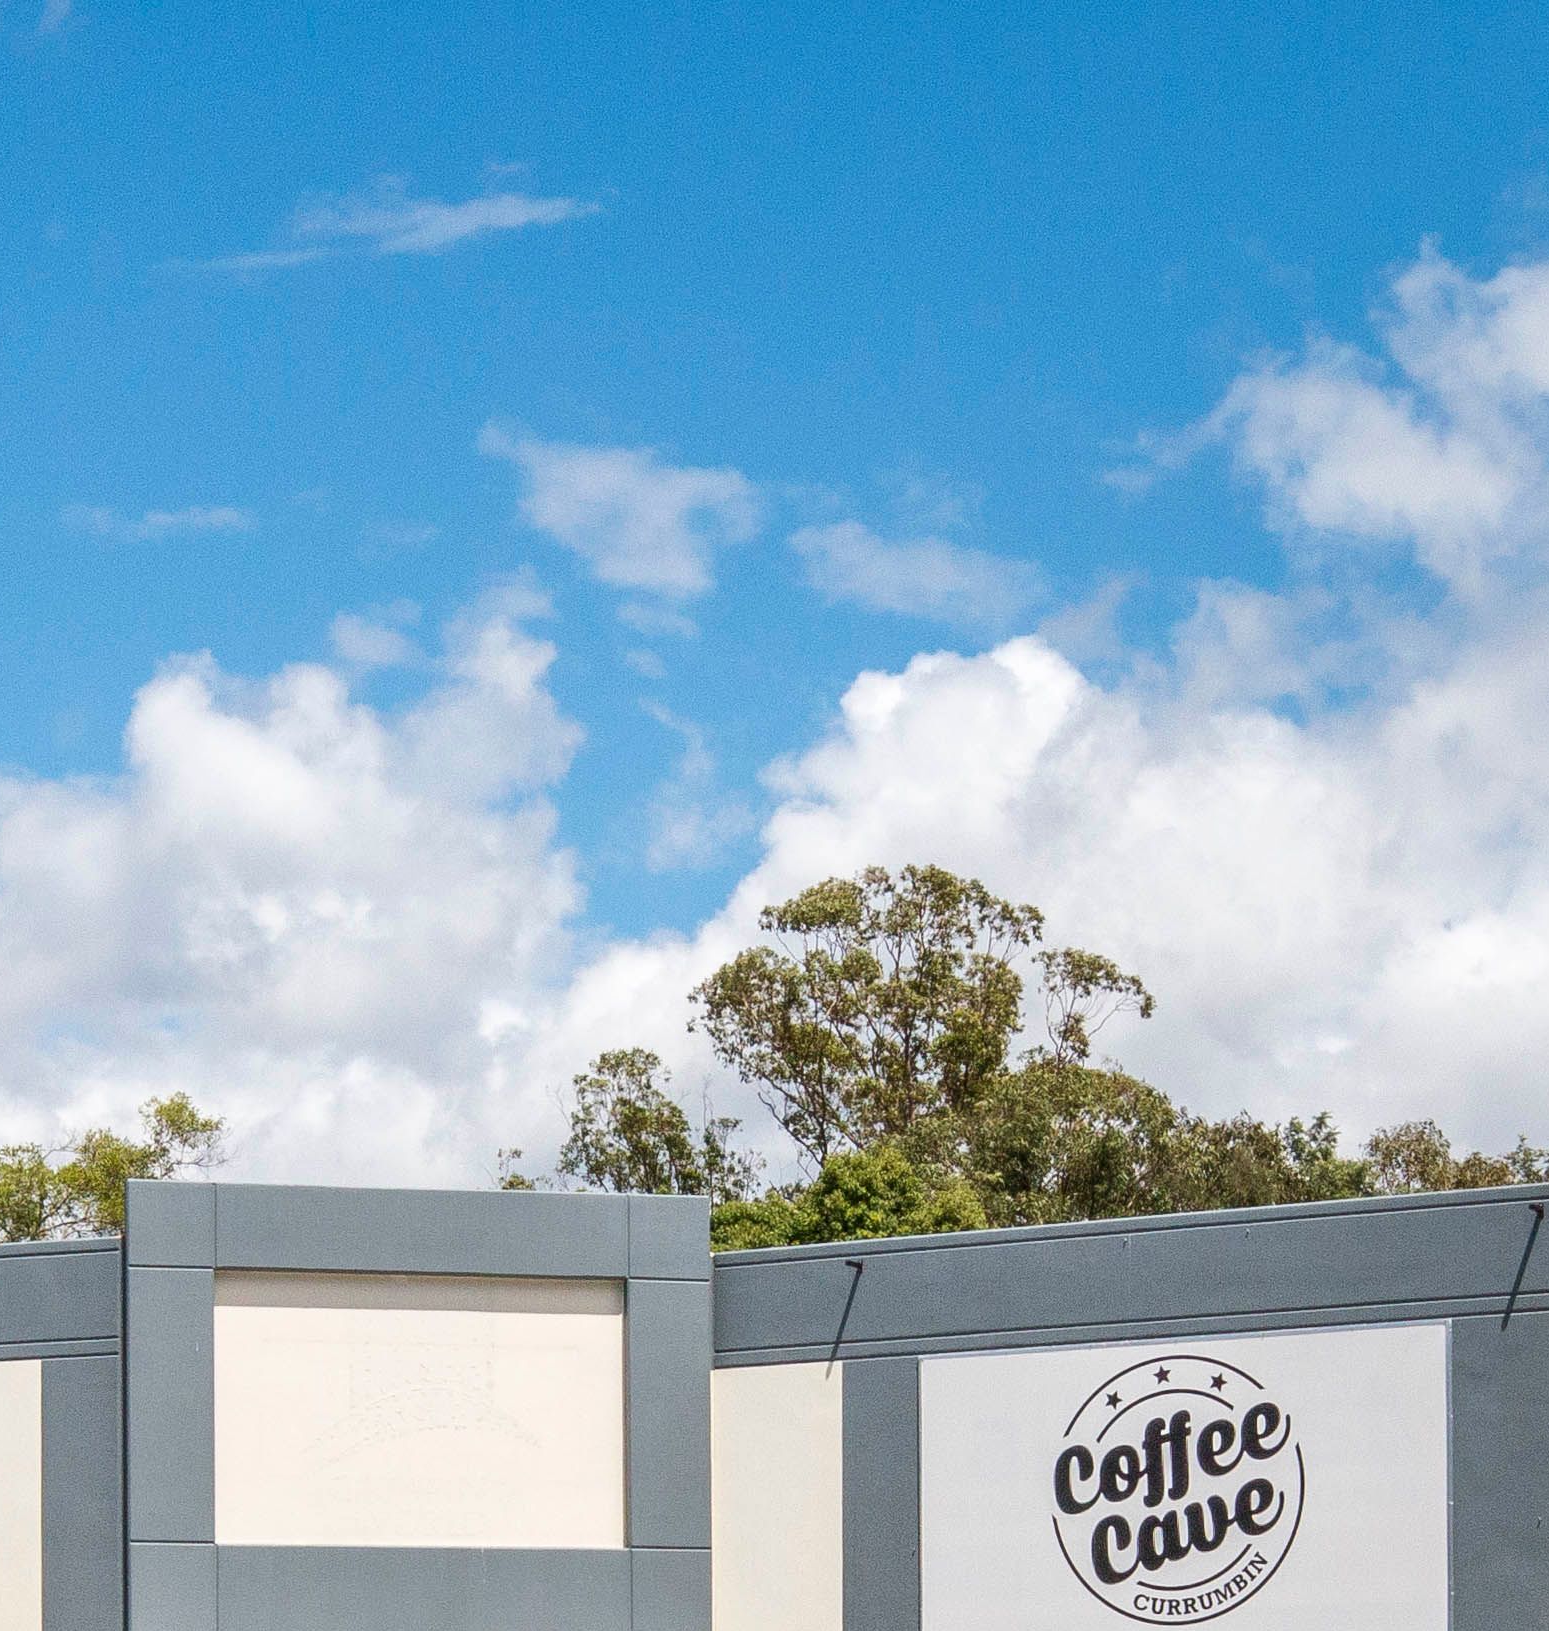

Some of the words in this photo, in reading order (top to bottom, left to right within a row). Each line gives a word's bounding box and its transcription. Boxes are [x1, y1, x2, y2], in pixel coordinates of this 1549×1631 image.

[1054, 1402, 1291, 1515] Coffee
[1091, 1478, 1284, 1584] Cave
[1133, 1551, 1268, 1617] CURRUMBIN
